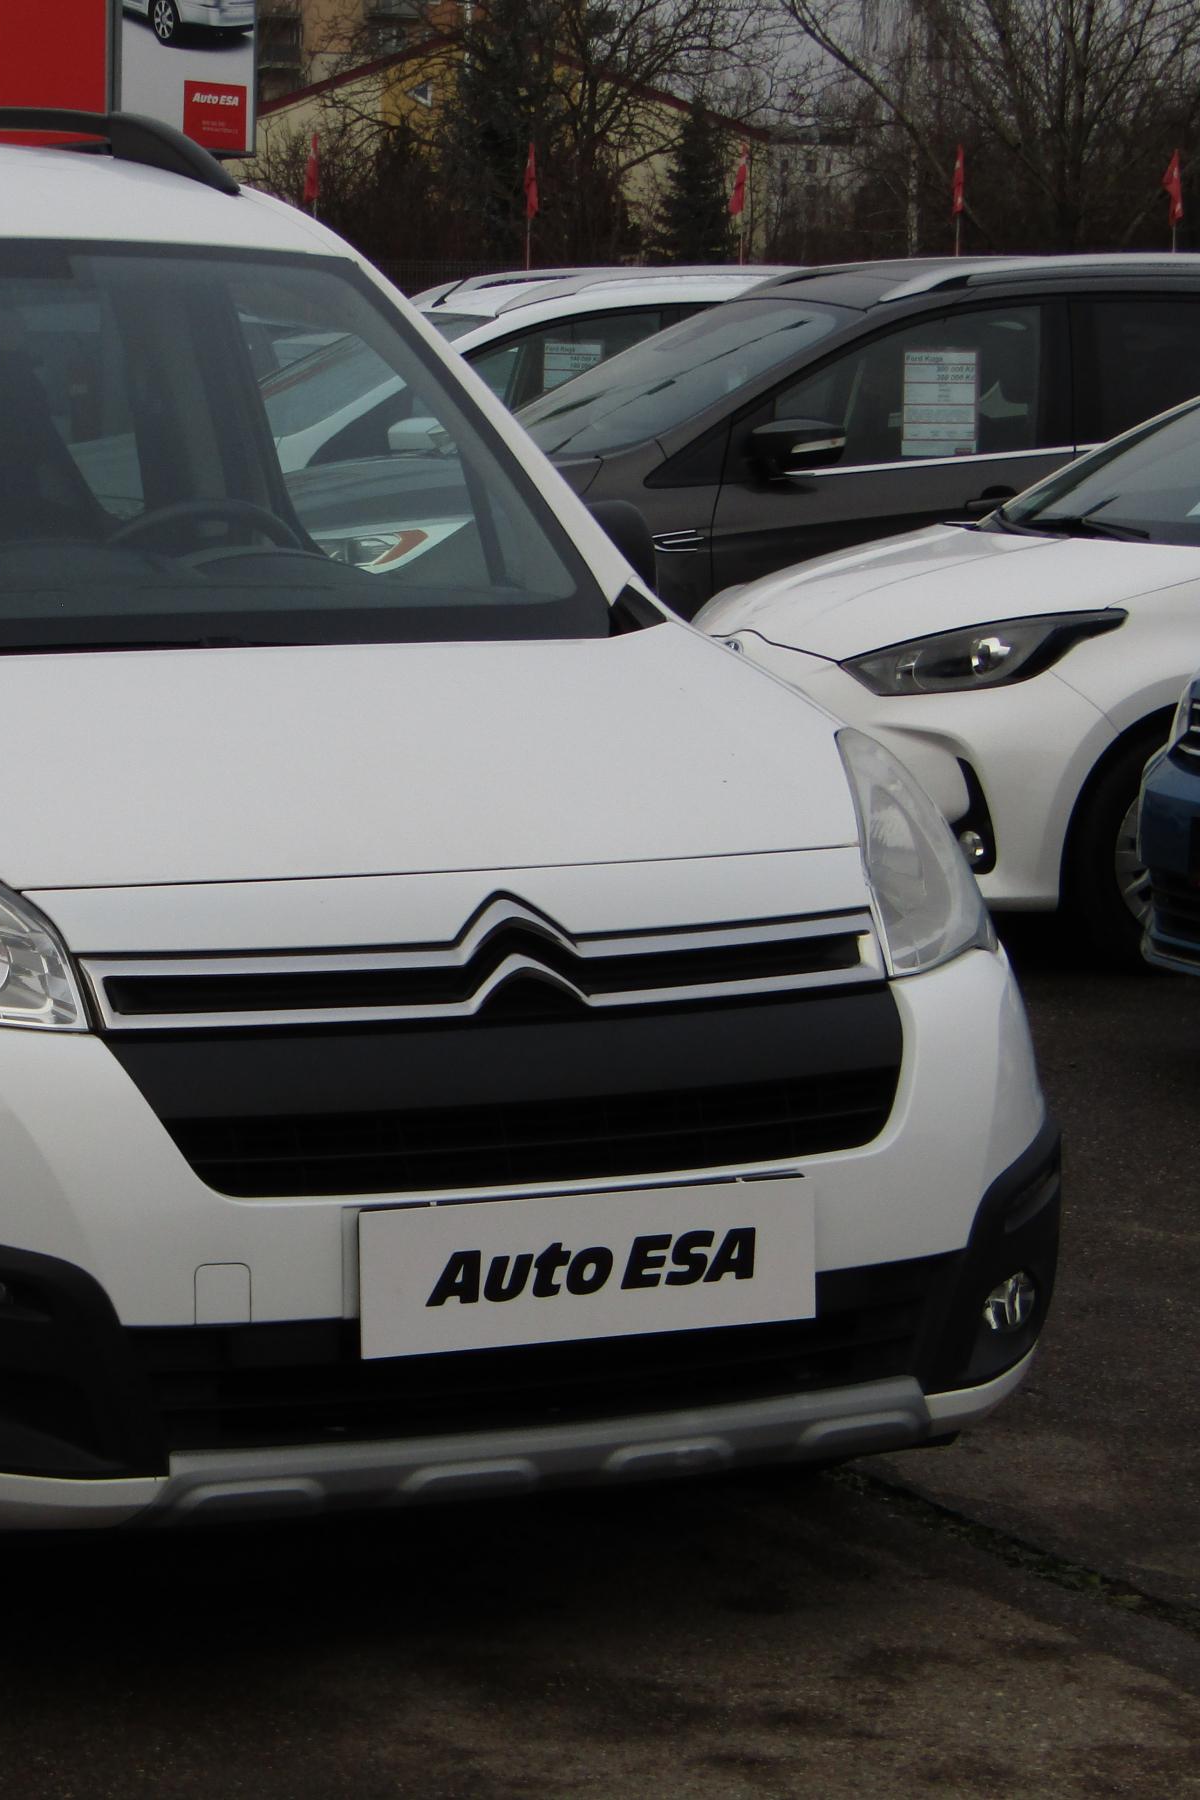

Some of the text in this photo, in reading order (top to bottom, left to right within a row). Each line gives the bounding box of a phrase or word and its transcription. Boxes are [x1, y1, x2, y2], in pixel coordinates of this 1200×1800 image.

[192, 92, 239, 106] Auto ESA
[425, 1226, 756, 1307] Auto ESA
